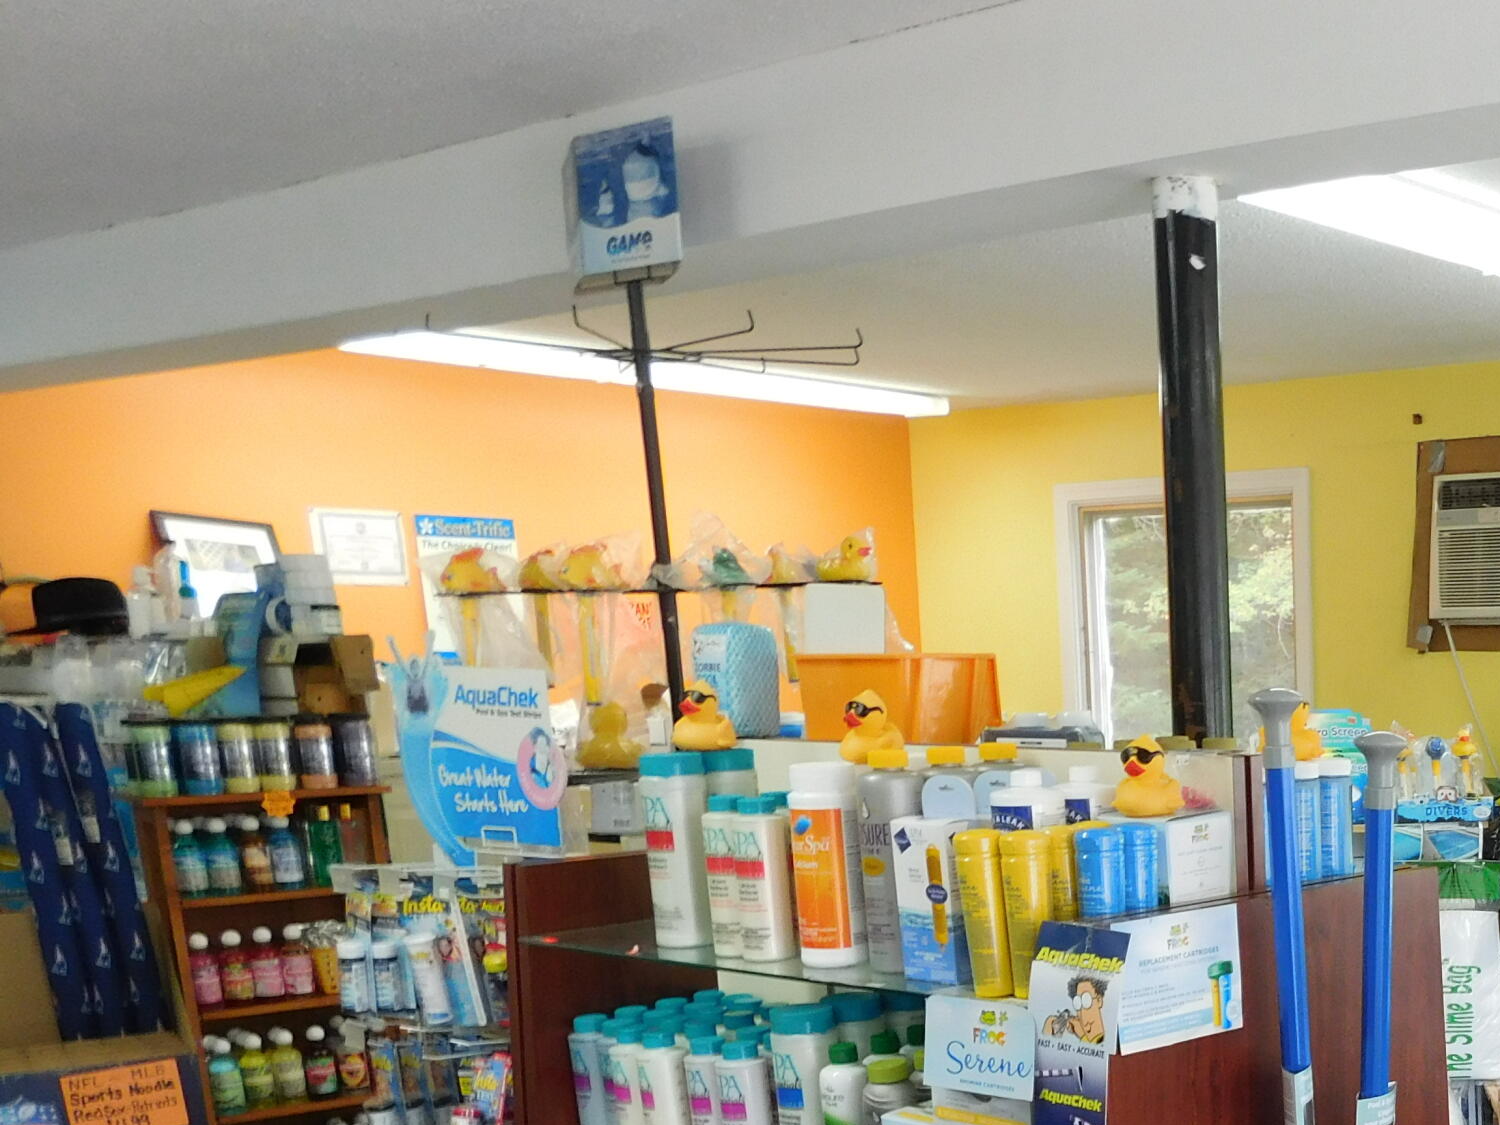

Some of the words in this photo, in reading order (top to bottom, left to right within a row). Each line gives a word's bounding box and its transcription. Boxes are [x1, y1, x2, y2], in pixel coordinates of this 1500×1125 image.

[454, 684, 539, 711] AquaChek
[474, 763, 511, 788] Water
[454, 791, 498, 813] Starts
[498, 788, 528, 816] Here
[1425, 806, 1469, 817] DIVERS
[1035, 946, 1124, 974] AquaChek
[1443, 964, 1482, 994] Bag
[972, 1027, 1006, 1047] FROG
[1446, 1002, 1473, 1046] Slime
[946, 1040, 1033, 1079] Serene
[1037, 1038, 1051, 1049] FAST
[1057, 1042, 1072, 1052] EASY
[1076, 1046, 1105, 1060] ACCURATE
[68, 1076, 97, 1092] NFL
[70, 1087, 123, 1109] Sports
[128, 1079, 176, 1097] Noodle
[1039, 1088, 1102, 1113] AquaChek
